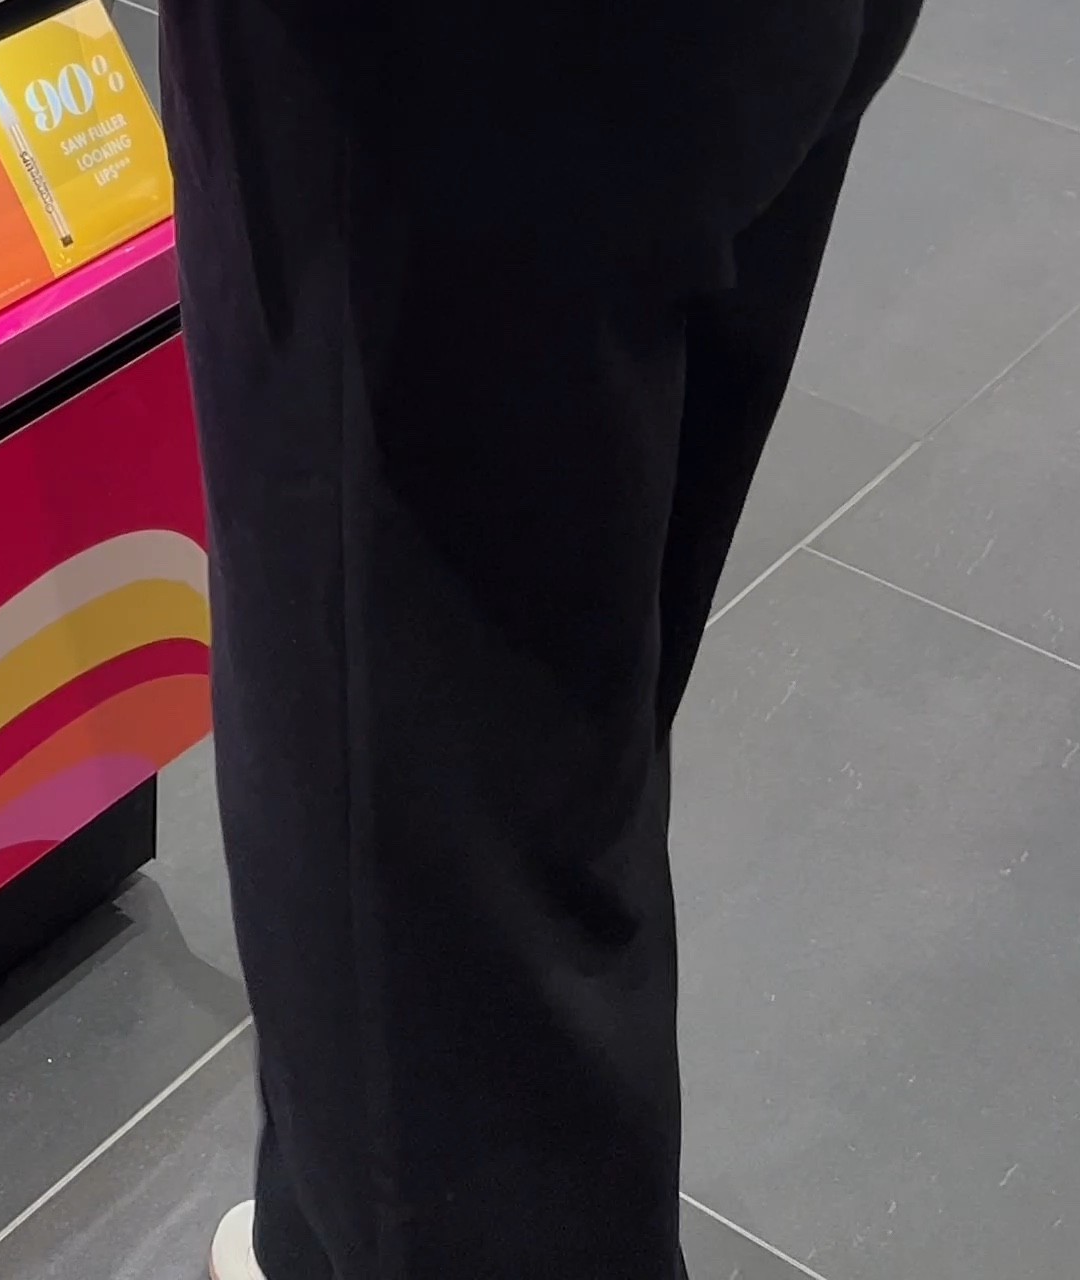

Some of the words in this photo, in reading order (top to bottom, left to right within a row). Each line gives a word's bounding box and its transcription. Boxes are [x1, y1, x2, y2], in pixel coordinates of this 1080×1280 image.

[24, 54, 125, 132] 90%
[60, 132, 88, 156] SAW
[87, 113, 128, 141] FULLER
[76, 134, 133, 172] LOOKING
